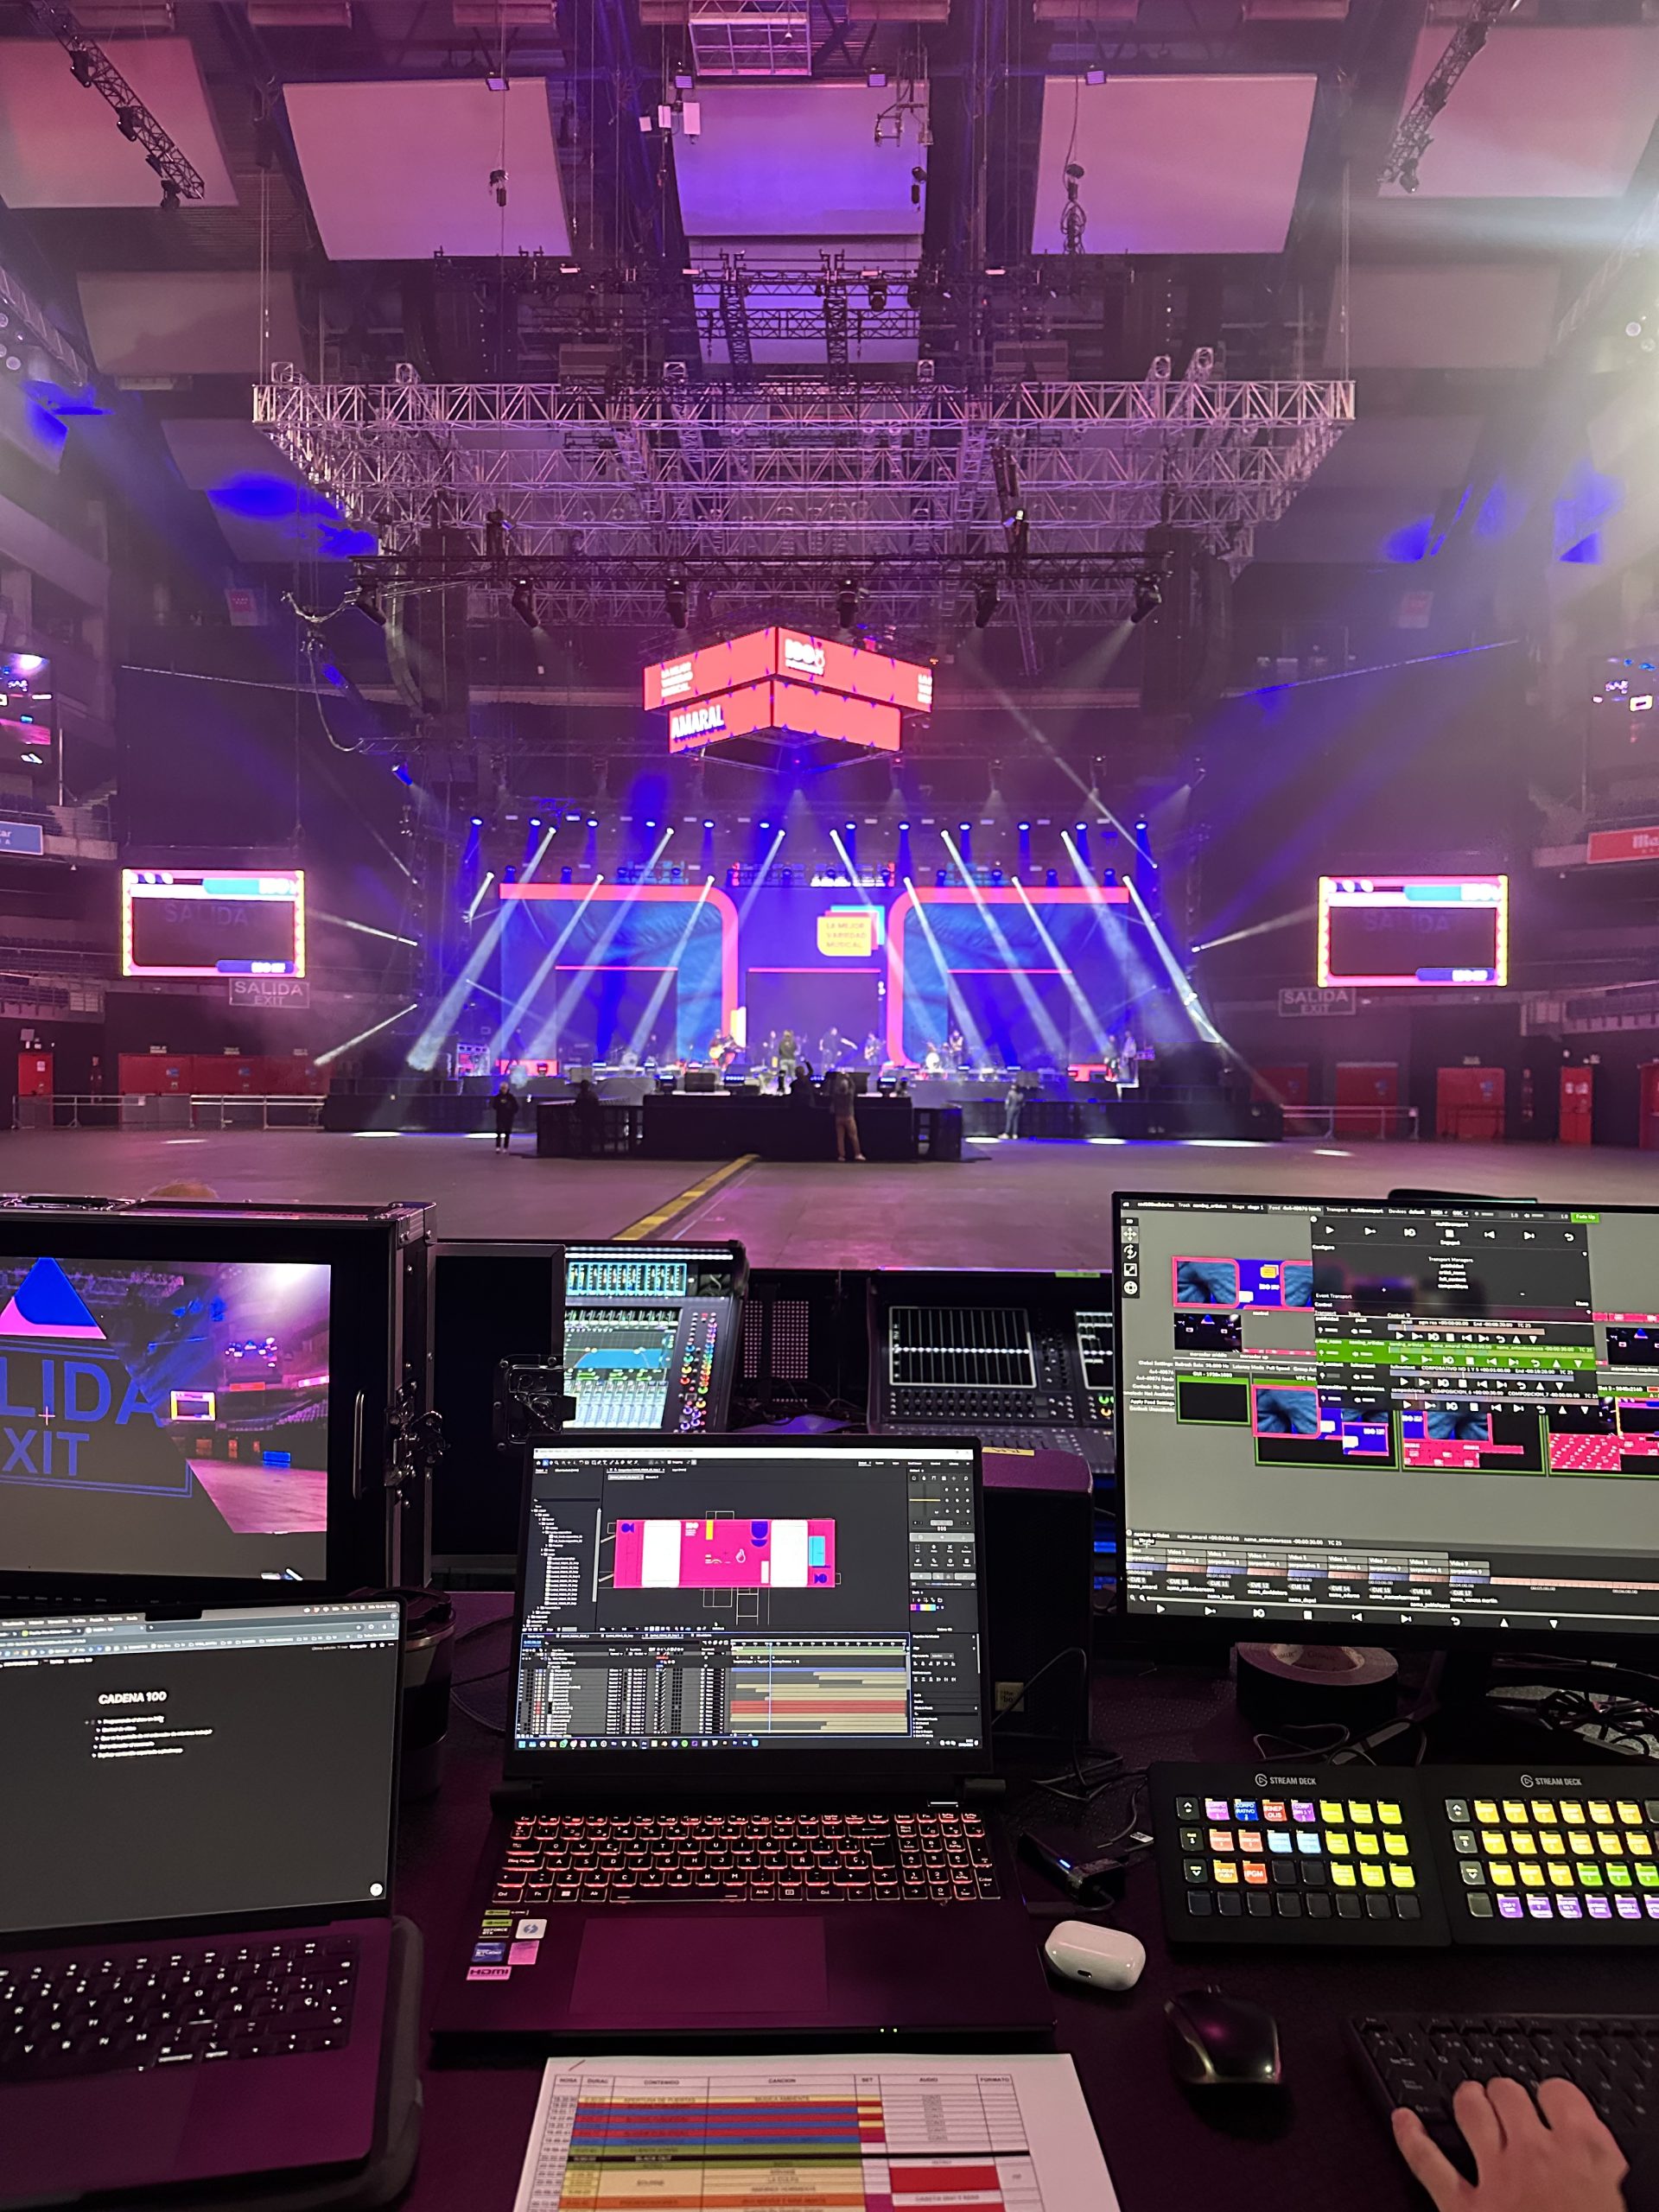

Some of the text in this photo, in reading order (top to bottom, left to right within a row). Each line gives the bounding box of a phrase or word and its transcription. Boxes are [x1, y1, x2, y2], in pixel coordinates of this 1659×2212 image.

[671, 703, 724, 740] AMARAL
[164, 904, 248, 925] SALIDA
[1365, 912, 1449, 933] SALIDA
[234, 981, 303, 996] SALIDA
[254, 995, 285, 1006] EXIT
[1283, 989, 1349, 1004] SALIDA
[1300, 1003, 1331, 1014] EXIT
[2, 1427, 90, 1477] XIT
[98, 1691, 167, 1705] CADENA 100
[1269, 1775, 1317, 1786] STREAM DECK
[1535, 1776, 1582, 1787] STREAM DECK
